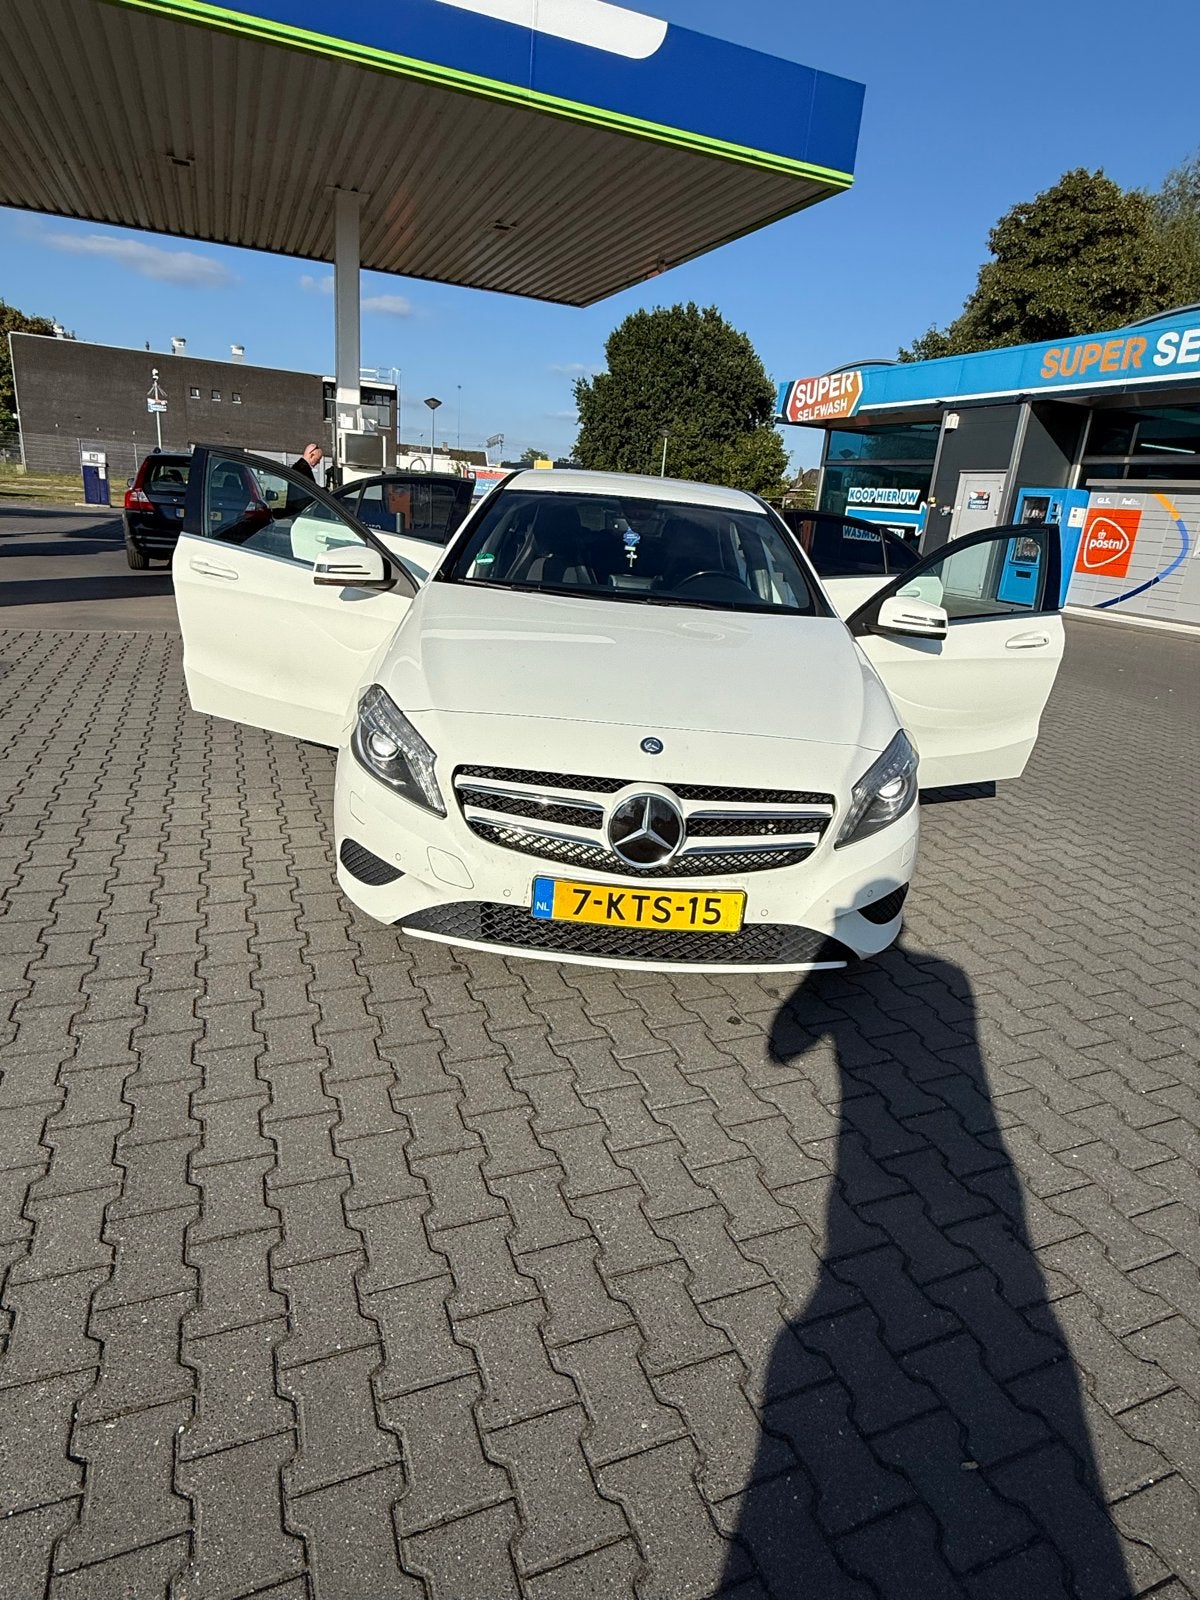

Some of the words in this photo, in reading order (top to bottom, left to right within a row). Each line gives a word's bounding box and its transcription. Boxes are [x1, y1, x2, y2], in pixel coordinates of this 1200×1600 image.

[1040, 336, 1148, 379] SUPER
[795, 372, 855, 408] SUPER
[796, 398, 848, 421] SELFWASH
[849, 488, 875, 502] KOOP
[876, 489, 899, 503] HIER
[900, 490, 919, 504] UW
[1089, 538, 1124, 551] postnl
[535, 902, 550, 912] NL
[572, 888, 722, 925] 7-KTS-15
